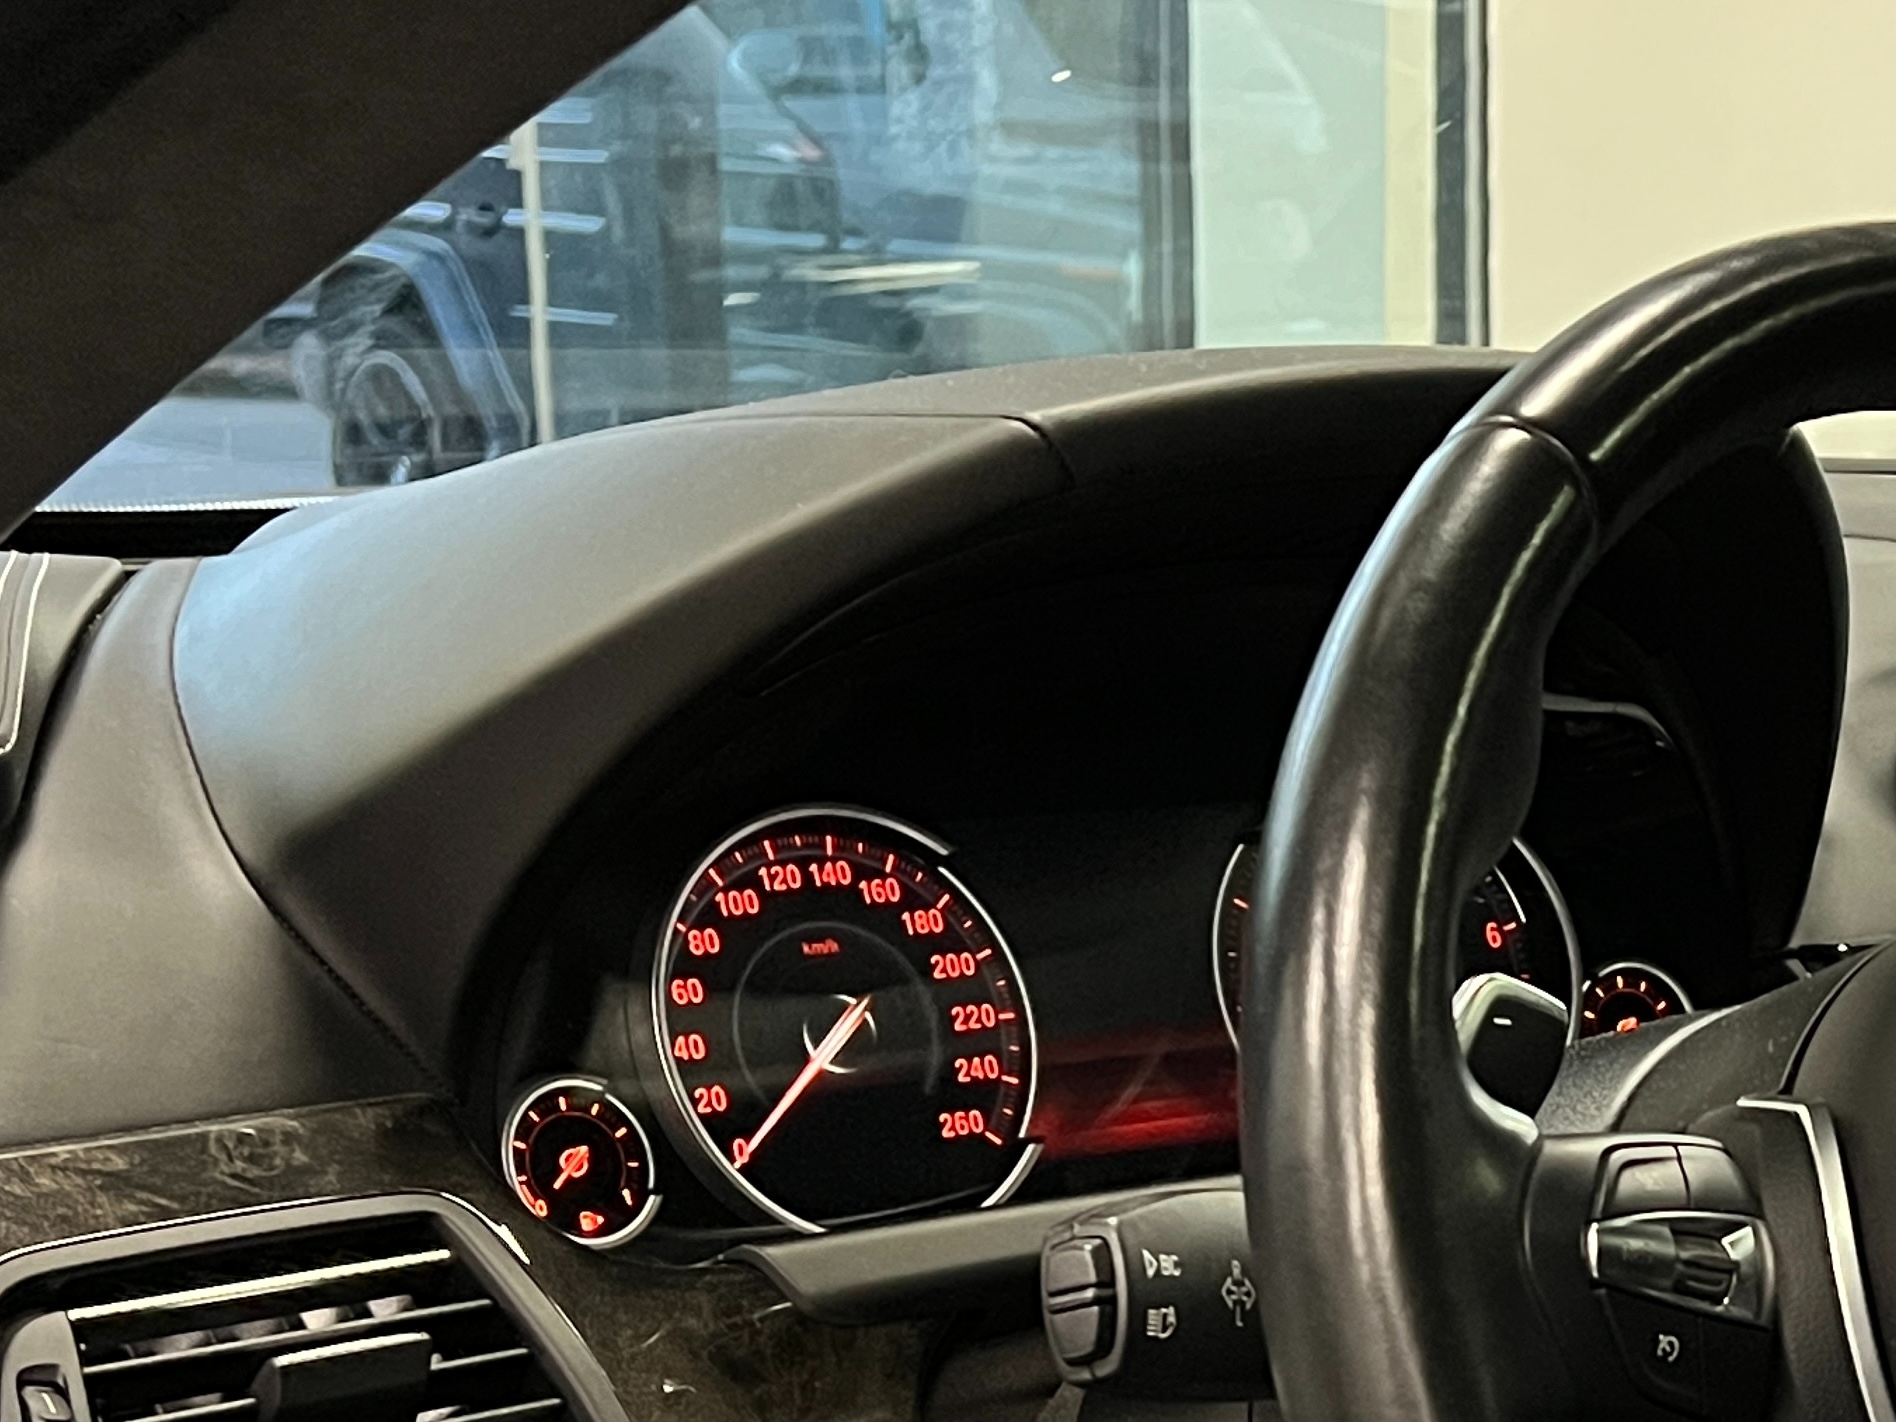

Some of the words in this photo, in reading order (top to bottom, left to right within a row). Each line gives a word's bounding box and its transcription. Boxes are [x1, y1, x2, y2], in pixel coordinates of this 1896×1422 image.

[758, 863, 802, 892] 120
[809, 860, 852, 888] 140
[715, 888, 760, 918] 100
[858, 877, 901, 905] 160
[901, 908, 944, 936] 180
[1485, 921, 1503, 949] 6
[687, 927, 721, 956] 80
[930, 951, 976, 980] 200
[670, 977, 704, 1006] 60
[951, 1003, 996, 1032] 220
[673, 1033, 707, 1061] 40
[954, 1054, 999, 1083] 240
[694, 1084, 728, 1114] 20
[938, 1109, 985, 1139] 260
[732, 1137, 750, 1165] 0
[1158, 1253, 1182, 1277] BC
